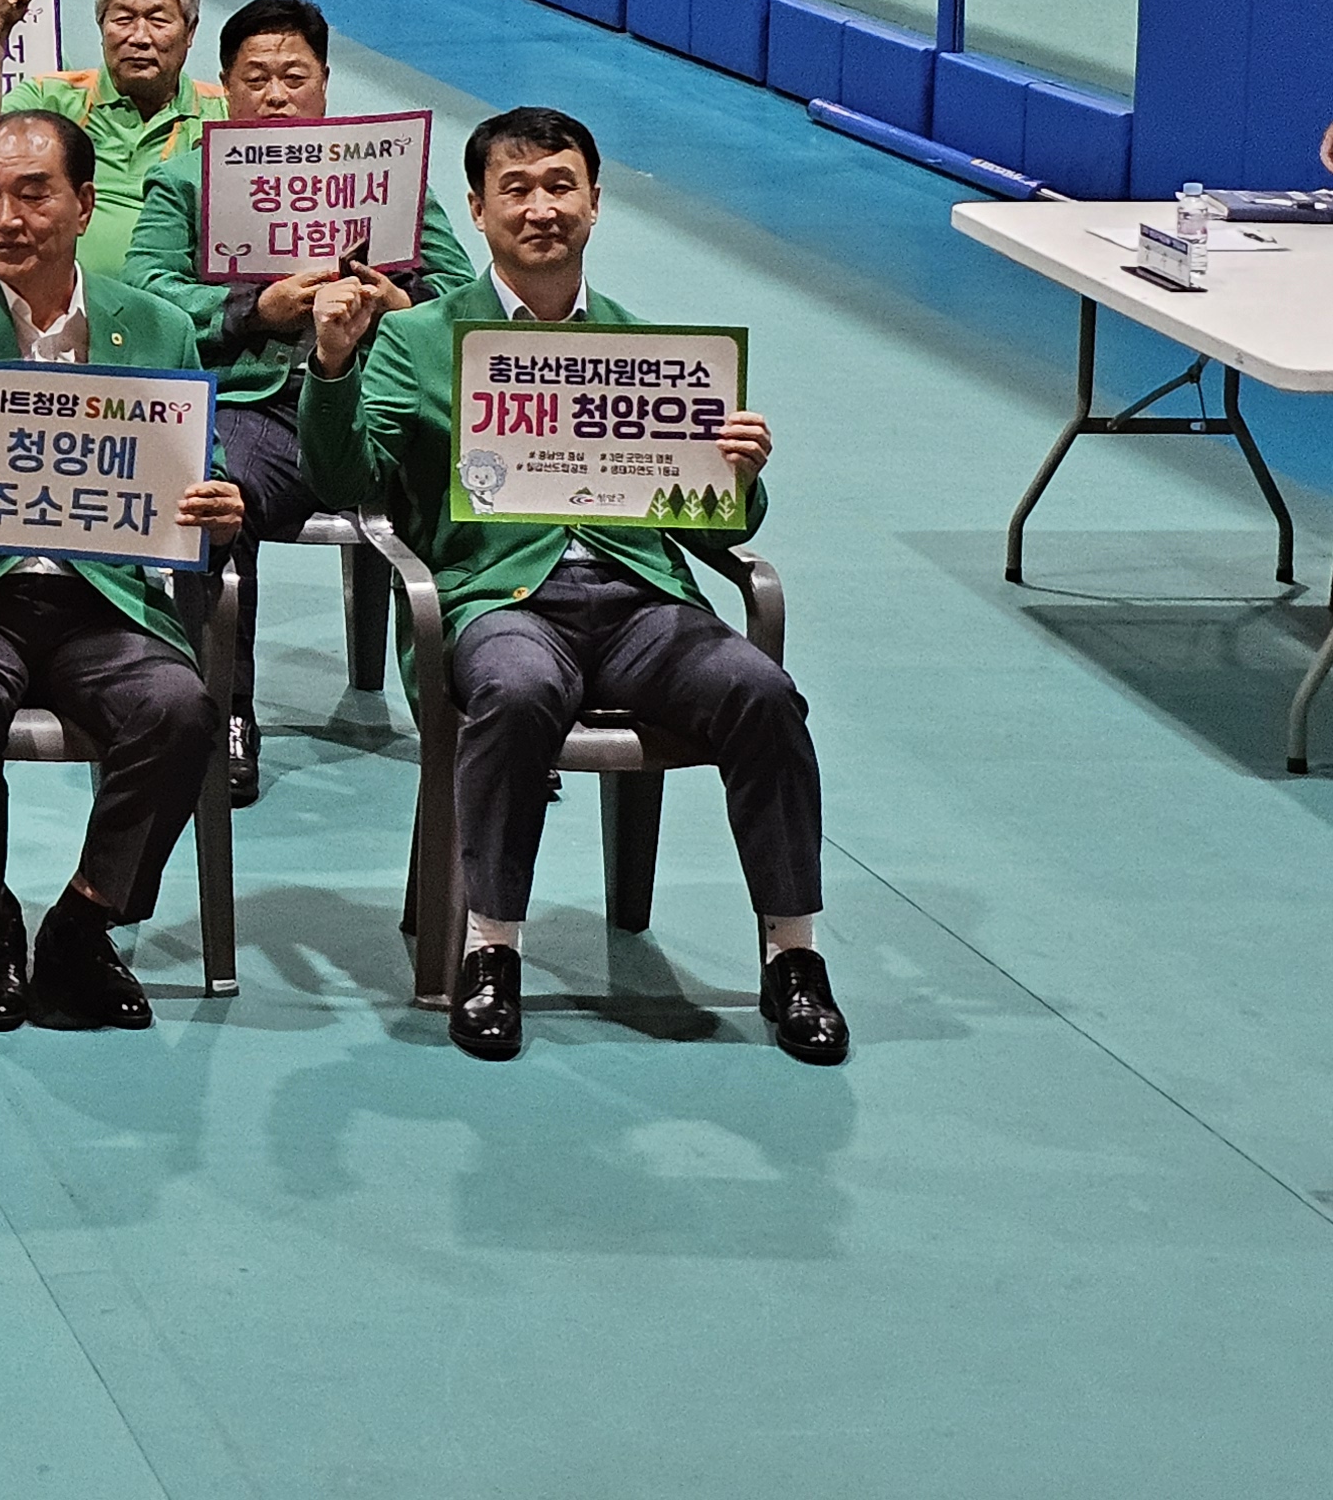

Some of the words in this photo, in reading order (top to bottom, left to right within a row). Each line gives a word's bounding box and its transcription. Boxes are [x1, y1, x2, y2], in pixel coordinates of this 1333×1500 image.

[224, 144, 323, 166] 스마트청양
[249, 170, 390, 213] 청양에서
[268, 217, 371, 258] 다함께
[488, 353, 712, 389] 충남산림자원연구소
[471, 390, 560, 437] 가자!
[571, 392, 725, 441] 청양으로
[6, 427, 139, 480] 청양에
